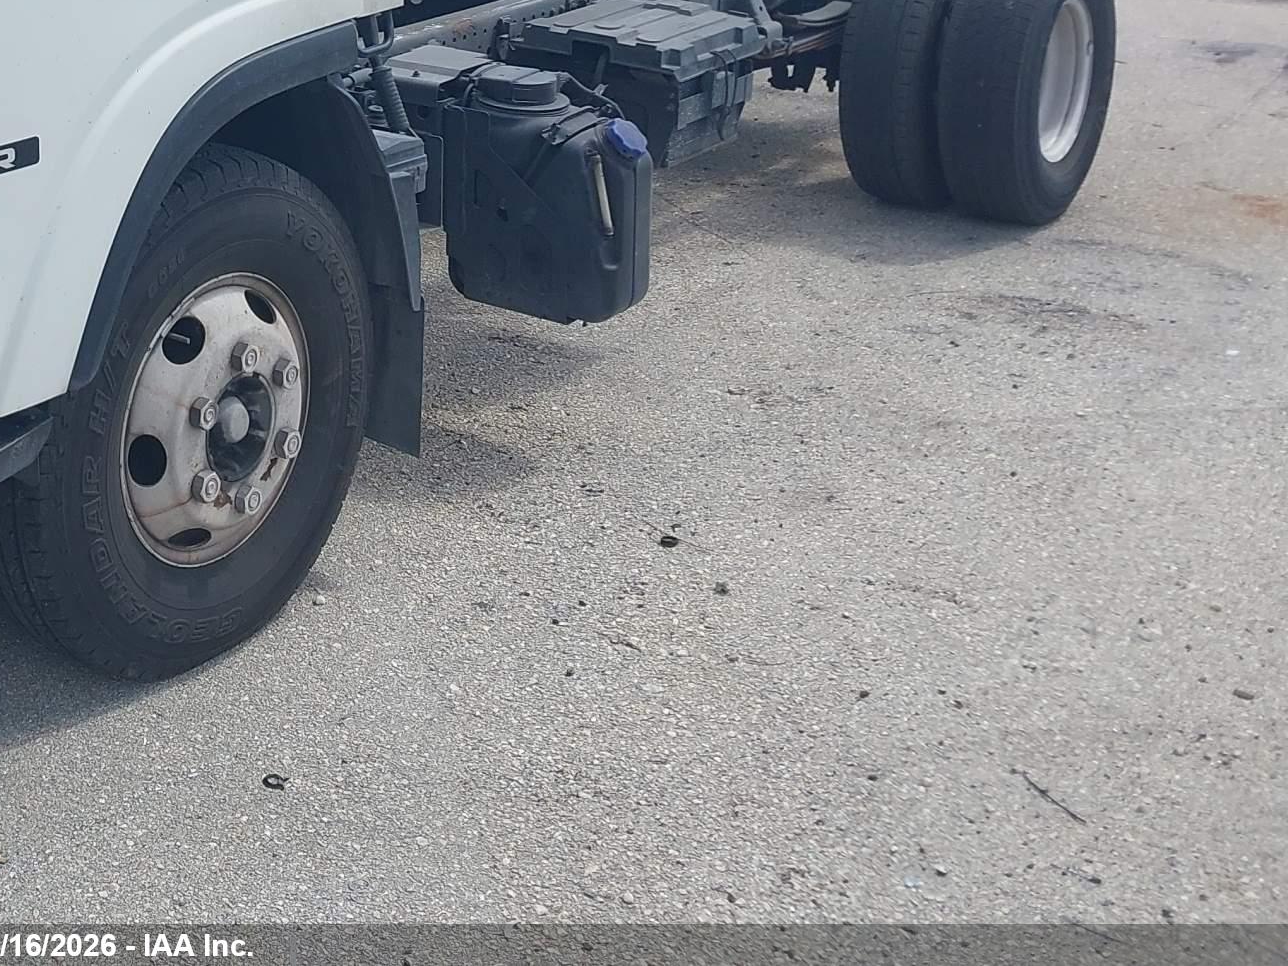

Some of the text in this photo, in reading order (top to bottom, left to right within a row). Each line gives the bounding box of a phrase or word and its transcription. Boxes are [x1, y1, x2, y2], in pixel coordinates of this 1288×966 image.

[285, 209, 363, 428] YOKOHAMA
[80, 322, 243, 644] GEOLANDAR H/T
